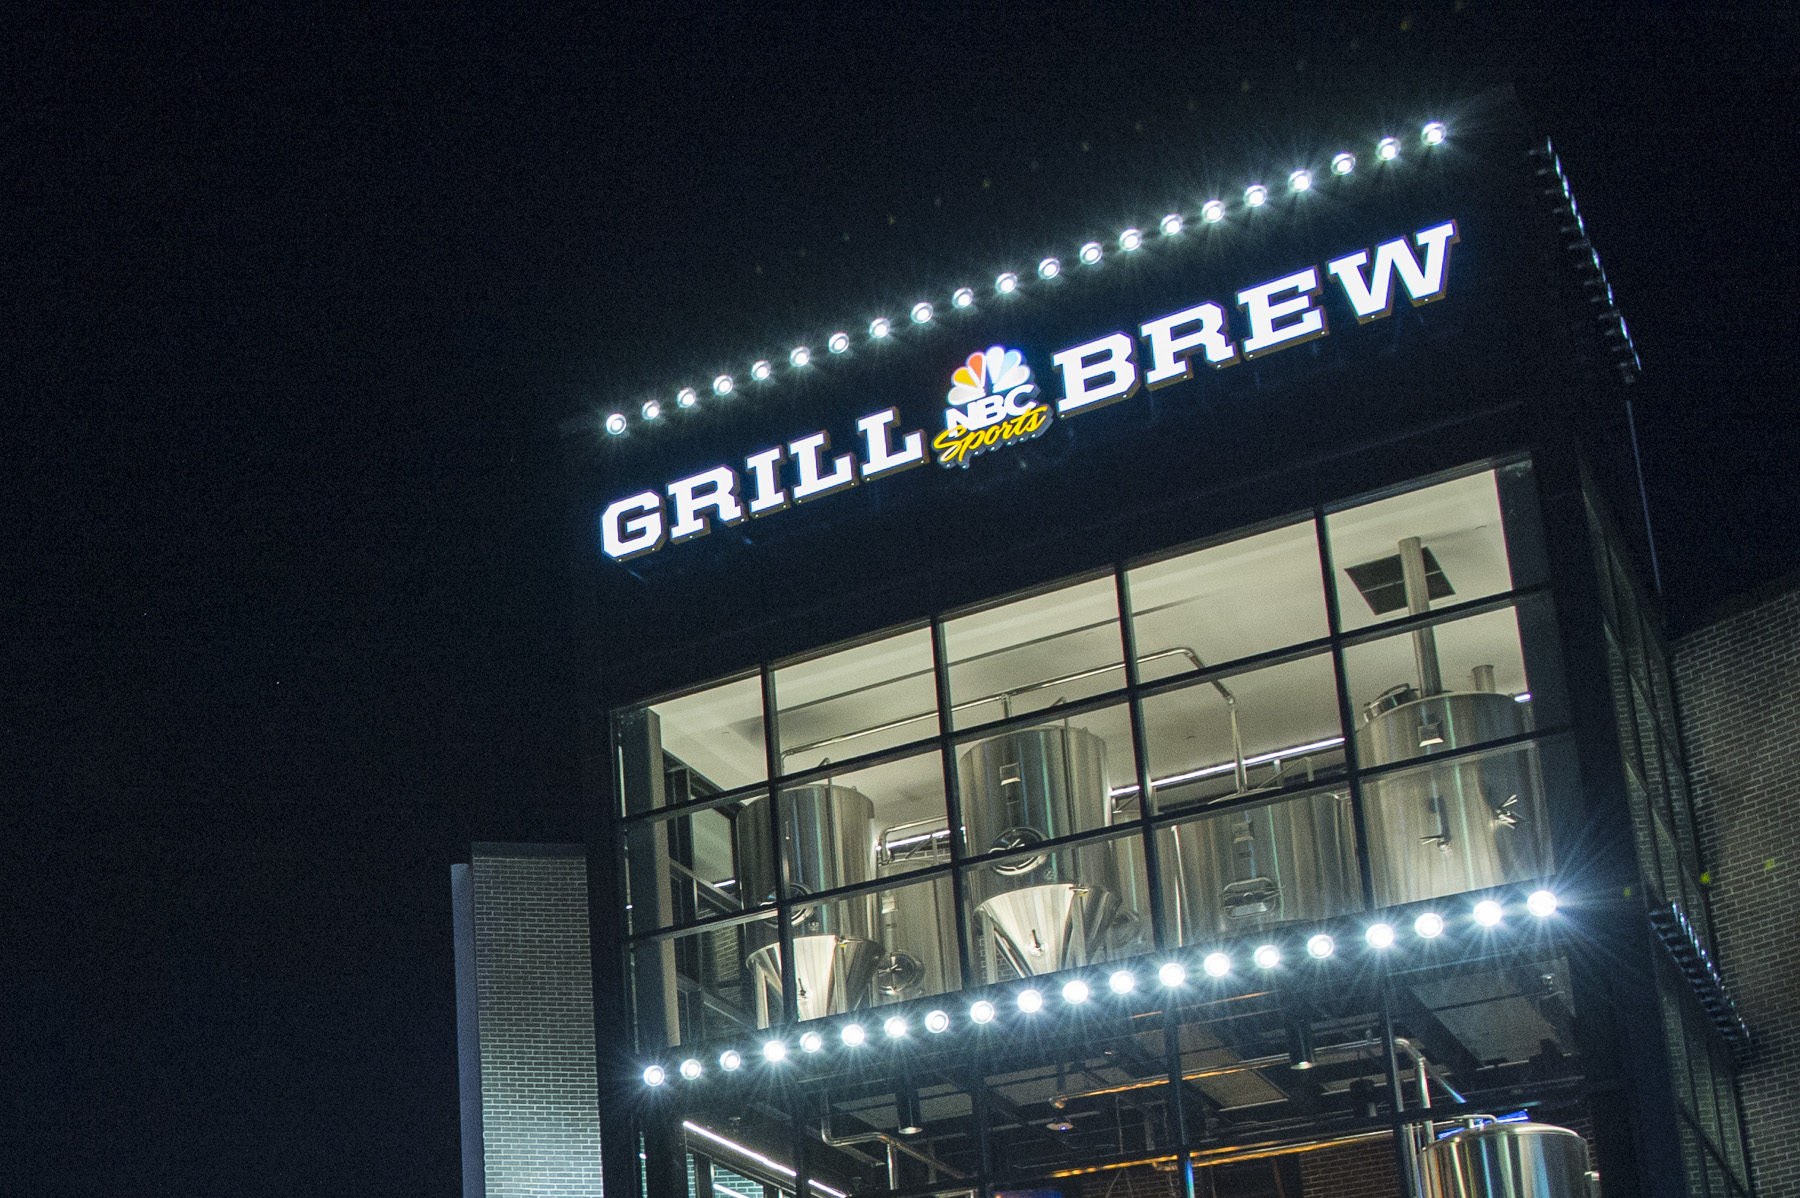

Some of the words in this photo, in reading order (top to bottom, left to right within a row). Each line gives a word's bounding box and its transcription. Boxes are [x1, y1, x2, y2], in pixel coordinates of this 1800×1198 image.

[601, 406, 930, 563] GRILL
[1052, 218, 1460, 418] BREW
[944, 384, 1039, 438] NBC
[933, 405, 1048, 462] Sports
